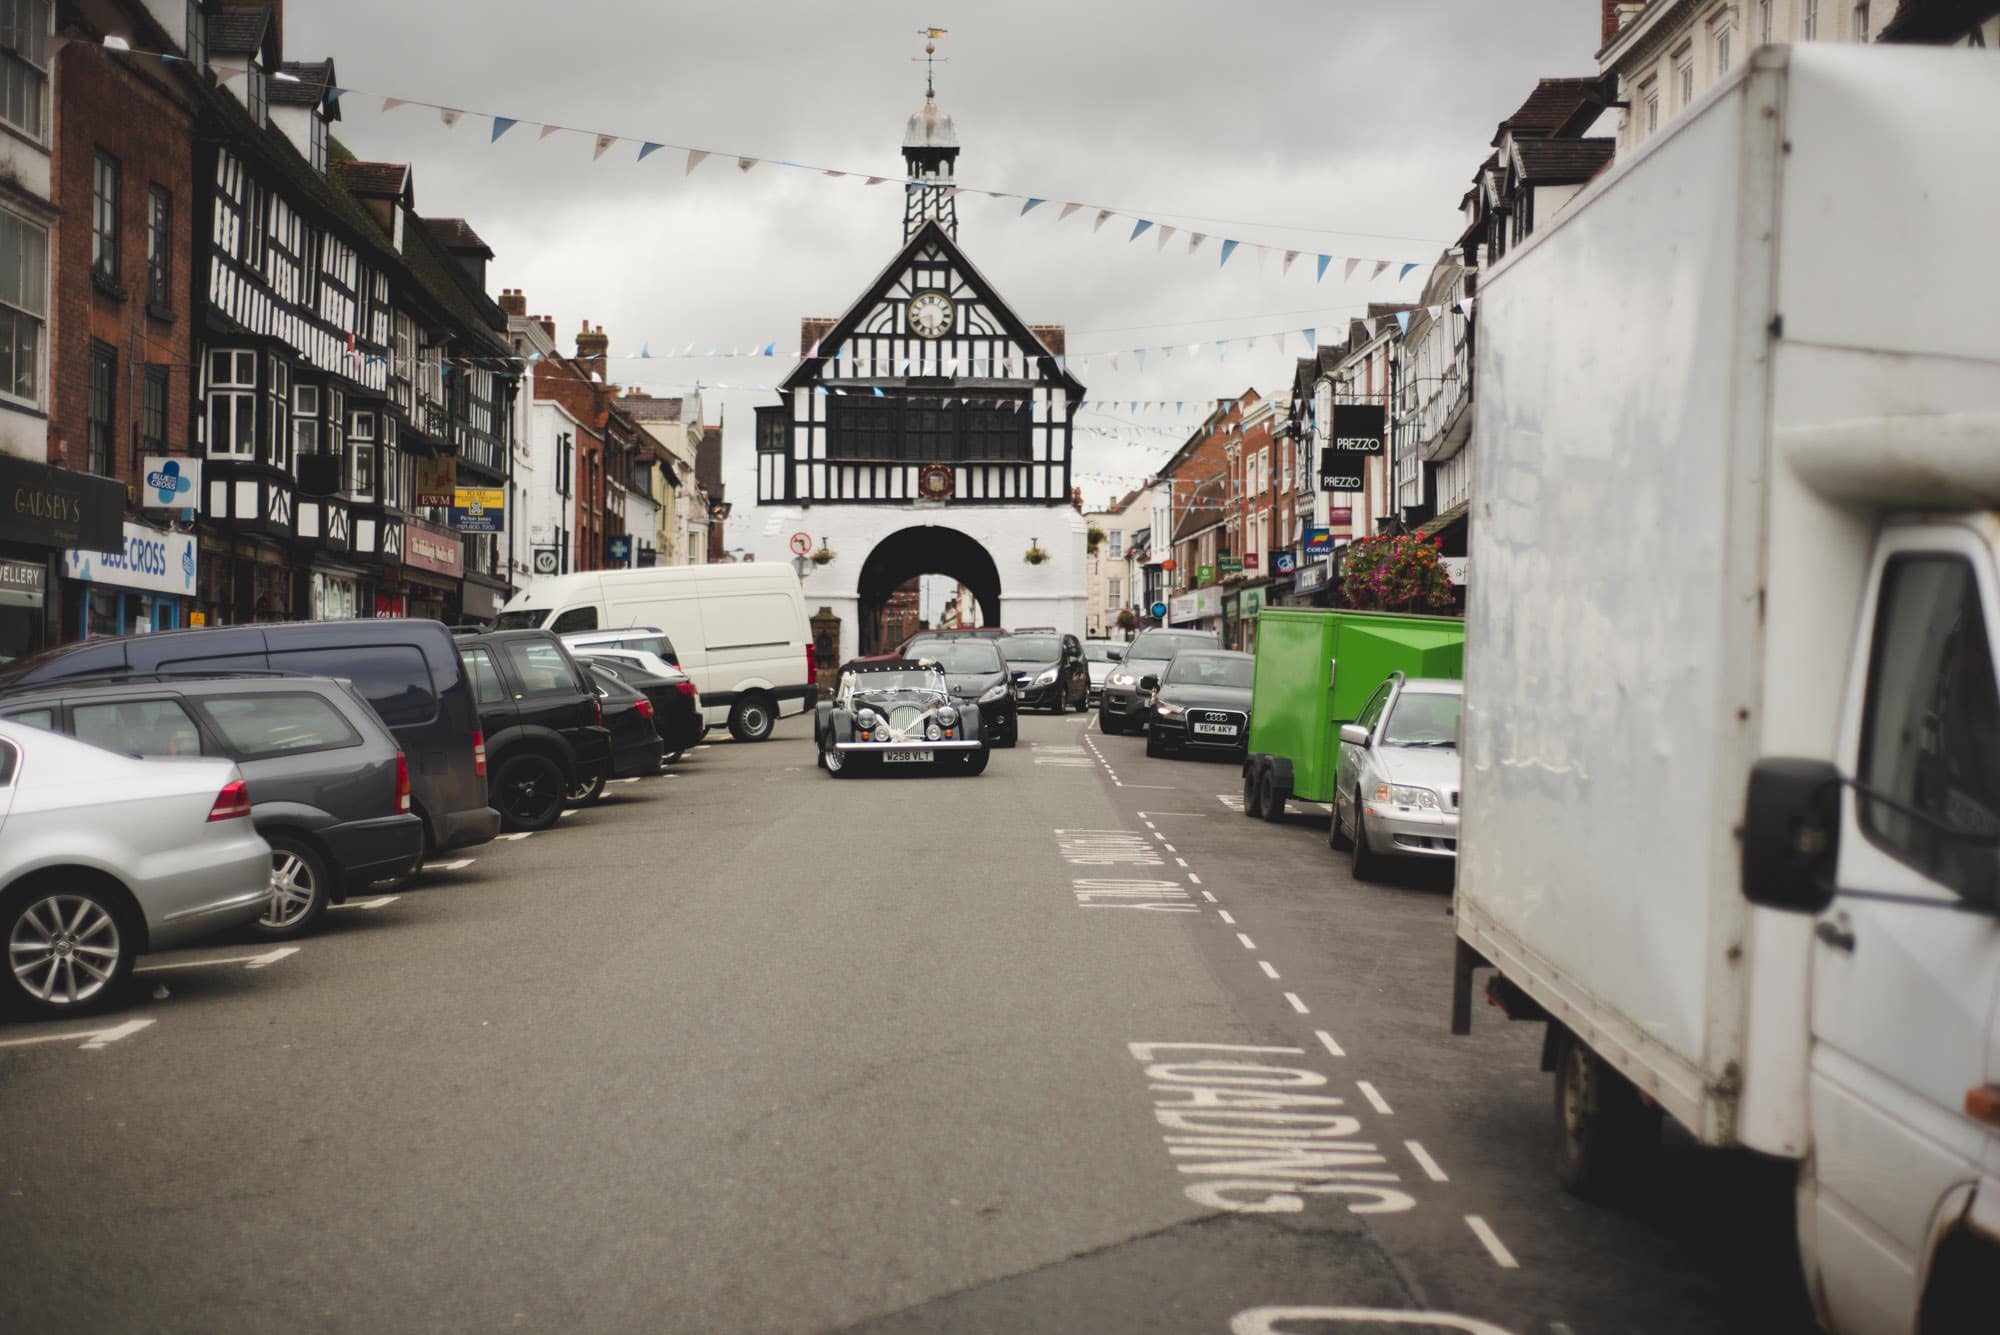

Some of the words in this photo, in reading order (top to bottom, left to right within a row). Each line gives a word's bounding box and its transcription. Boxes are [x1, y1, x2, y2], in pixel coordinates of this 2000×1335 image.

[1337, 438, 1380, 450] PREZZO
[151, 480, 176, 490] CROSS
[1324, 477, 1360, 488] PREZZO
[422, 495, 450, 505] EWM
[130, 537, 166, 576] CROSS
[887, 751, 910, 760] W258
[912, 751, 930, 760] VLT
[1128, 1041, 1417, 1214] LOADING
